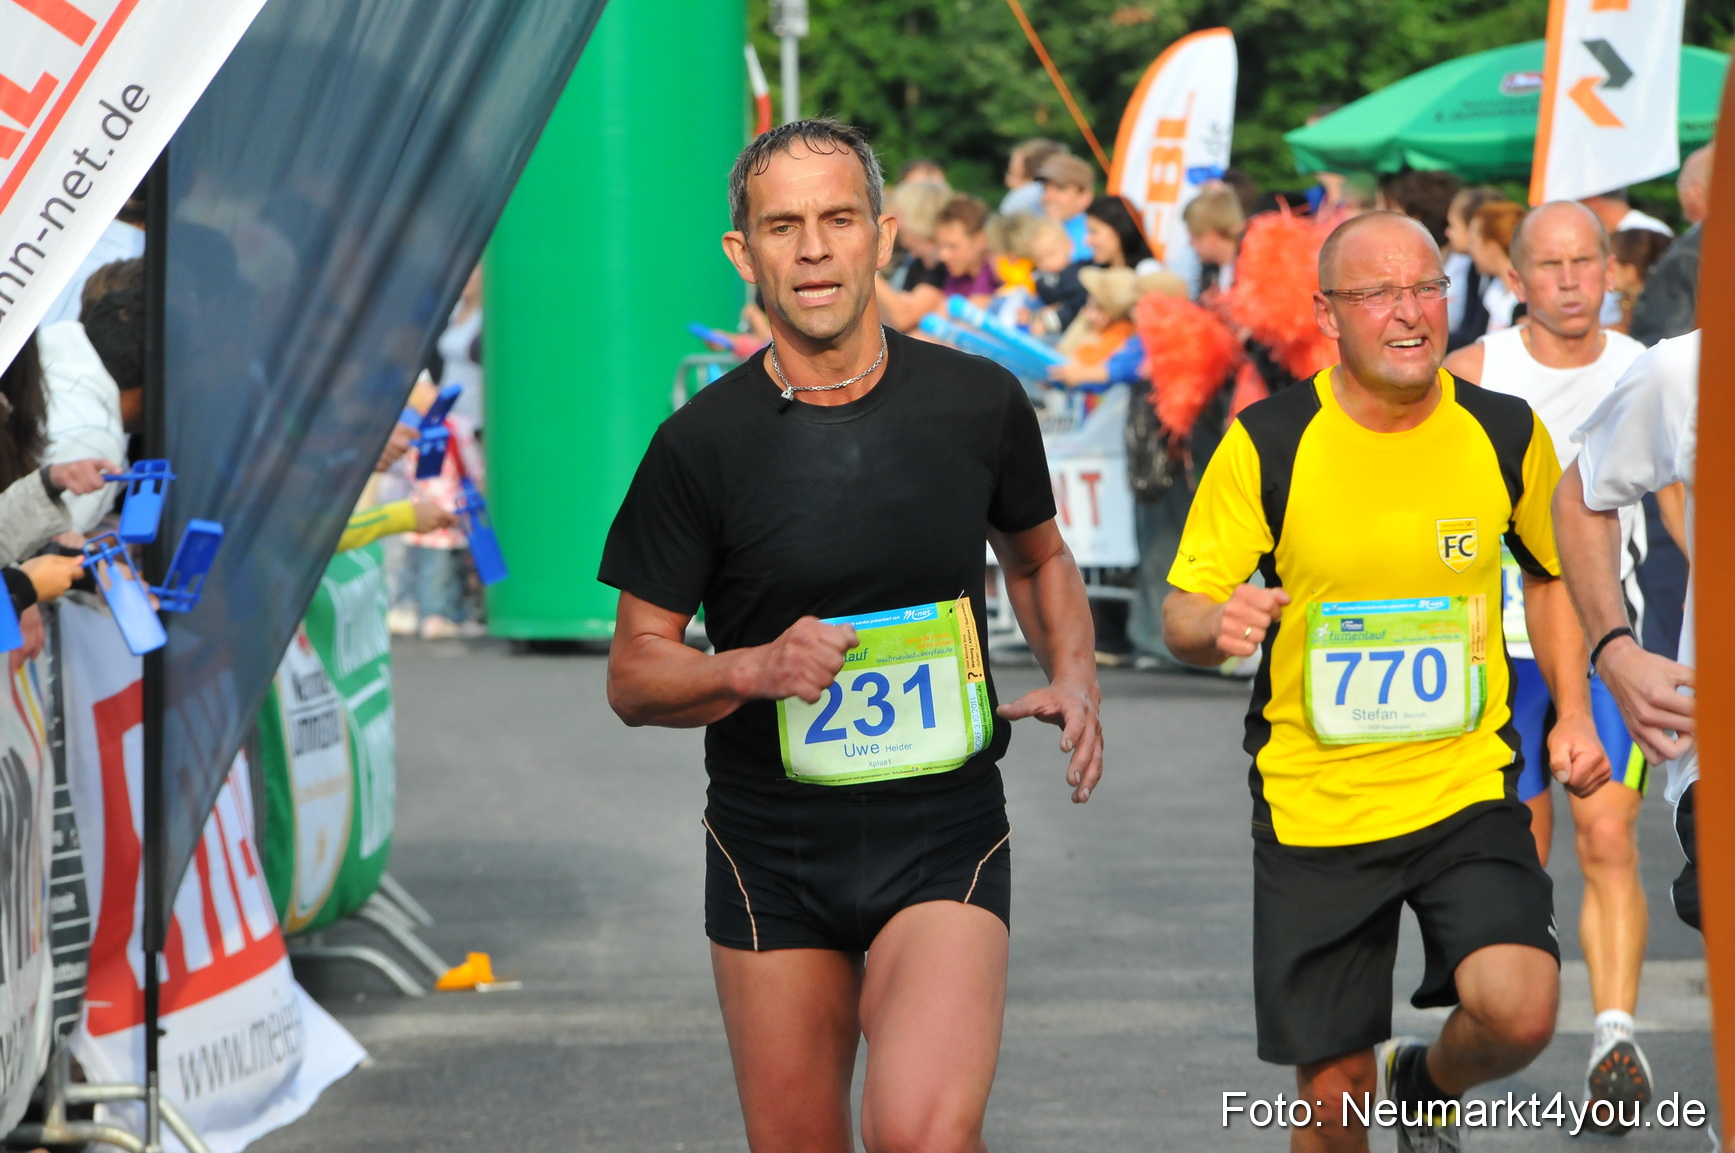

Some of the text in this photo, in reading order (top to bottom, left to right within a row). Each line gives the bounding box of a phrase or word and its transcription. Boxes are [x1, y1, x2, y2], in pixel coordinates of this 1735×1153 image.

[1444, 535, 1473, 558] FC
[903, 608, 935, 620] M-net
[1325, 647, 1447, 706] 770
[804, 663, 936, 745] 231
[1352, 708, 1398, 721] Stefan
[843, 741, 912, 758] Uwe Heider
[868, 758, 892, 768] Xplus1
